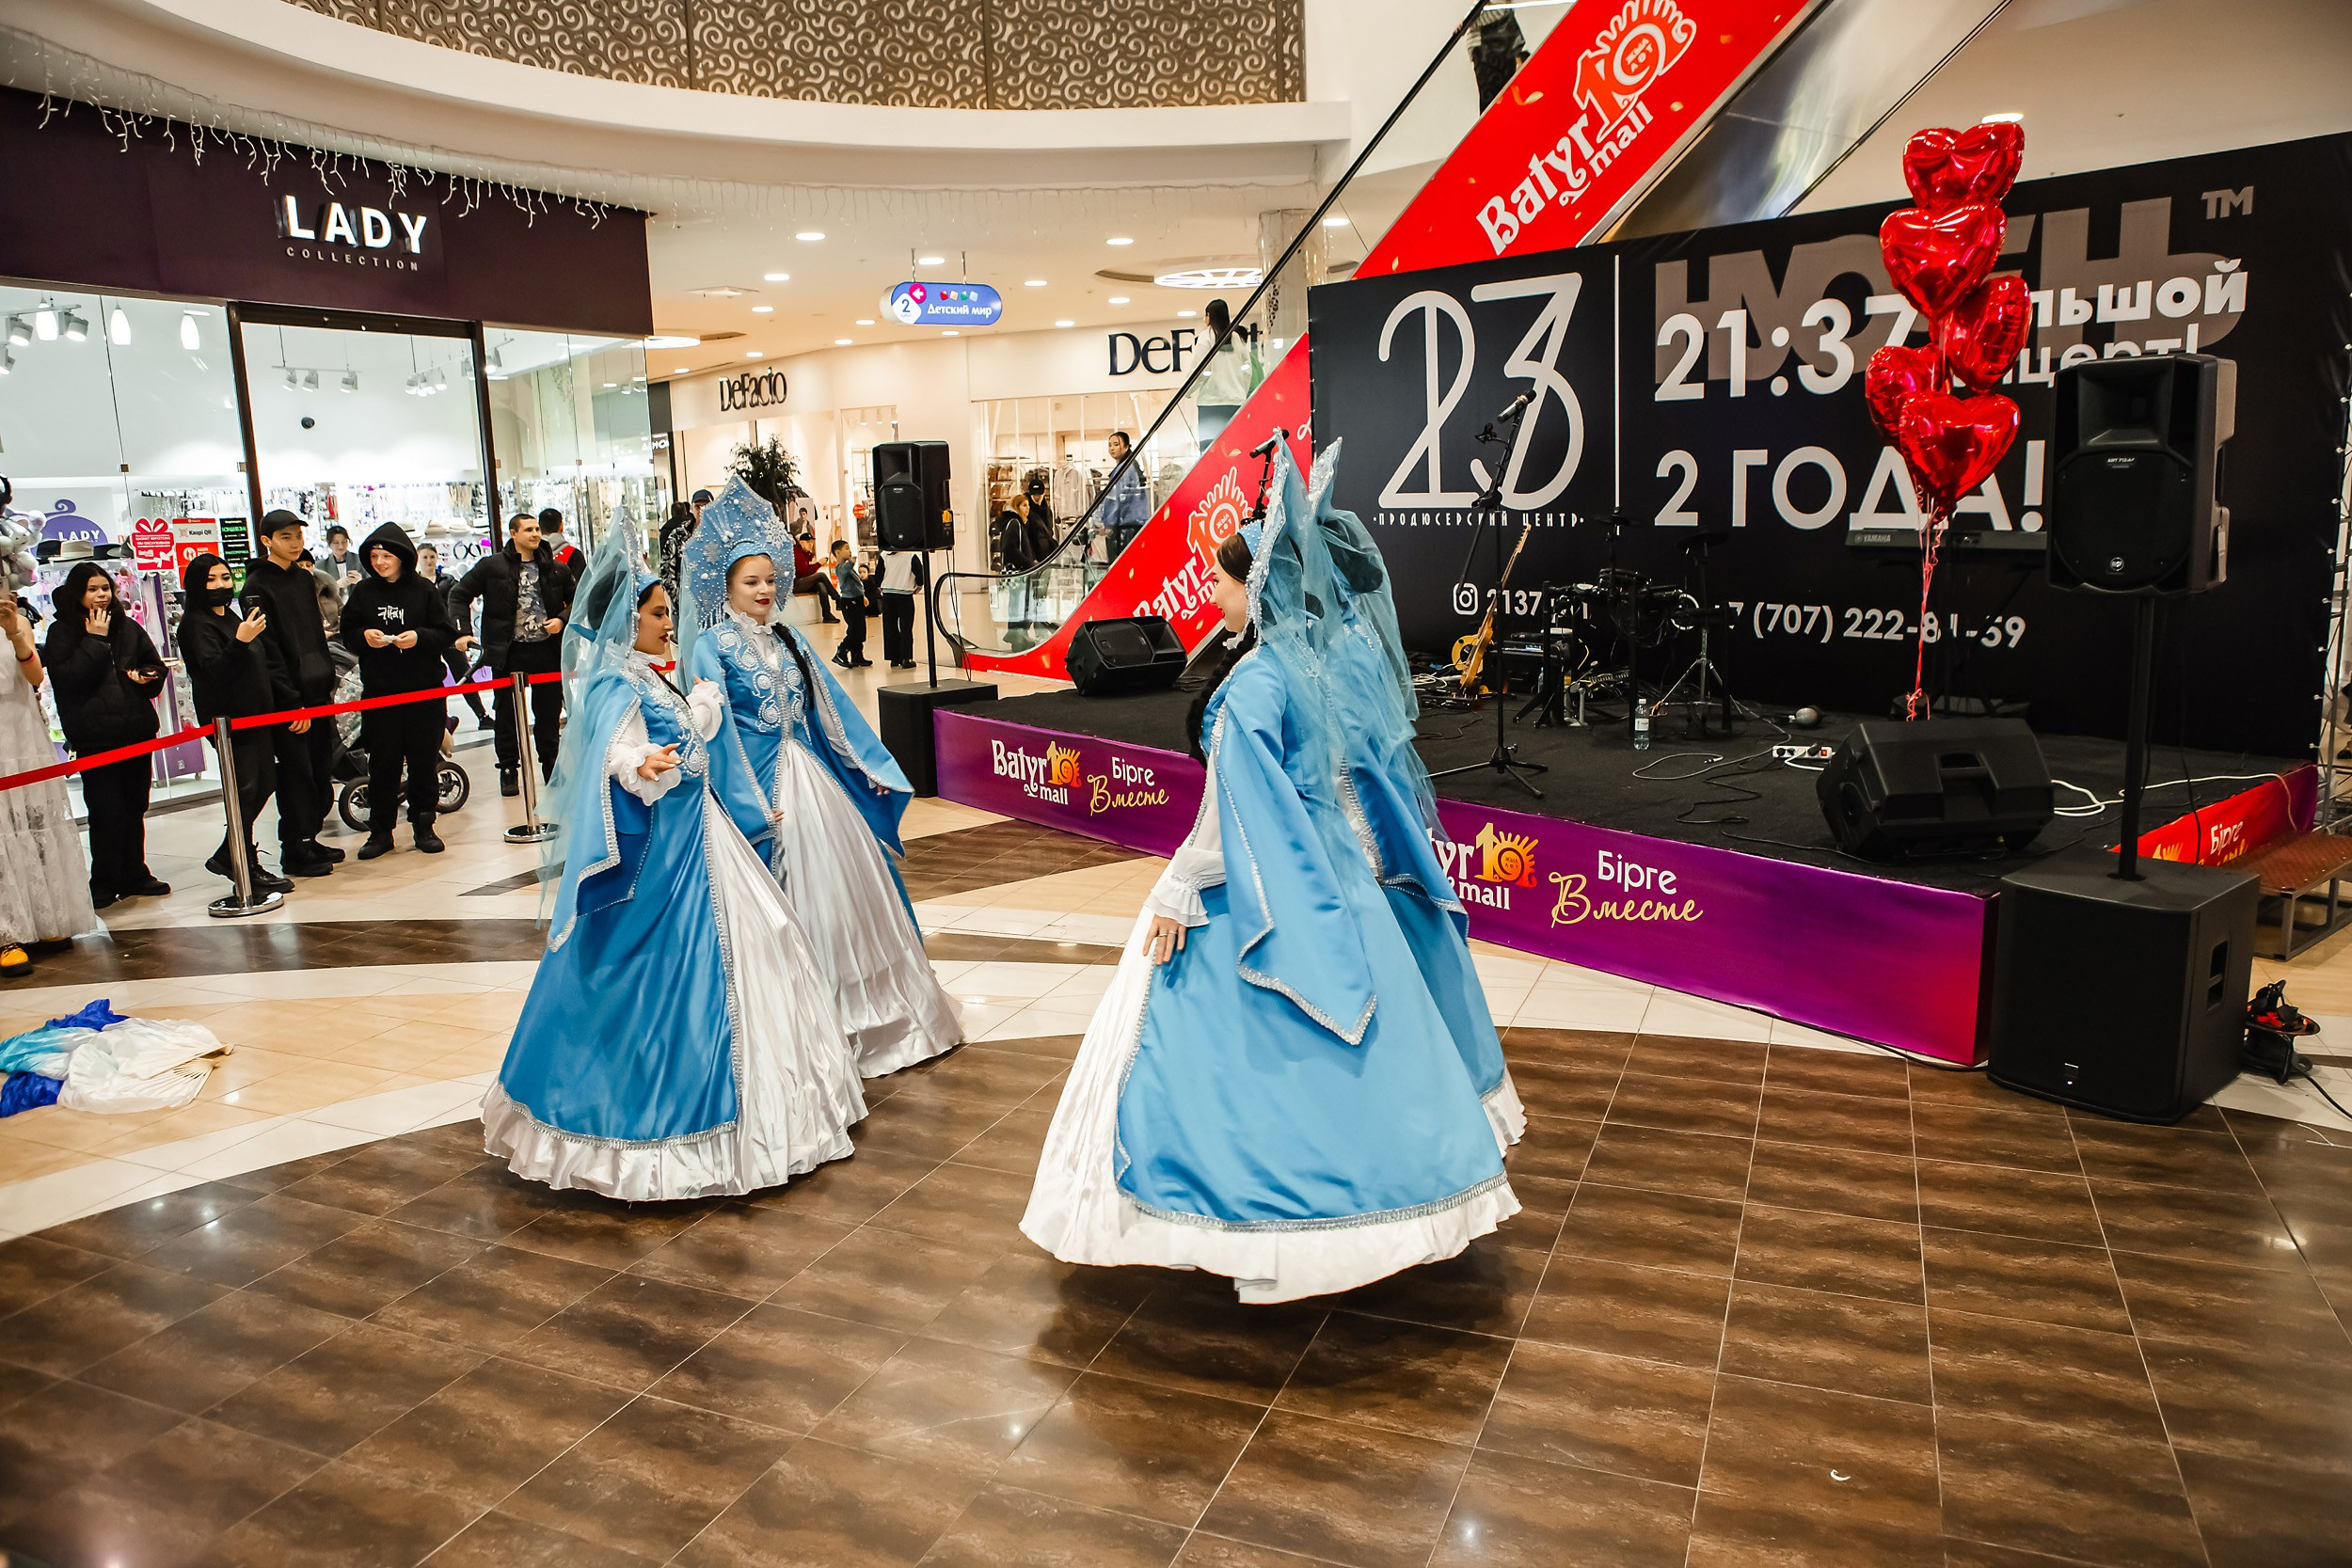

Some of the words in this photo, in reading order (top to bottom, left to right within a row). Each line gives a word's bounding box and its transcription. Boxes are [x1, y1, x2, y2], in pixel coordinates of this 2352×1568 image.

[1588, 101, 1654, 177] mall
[1475, 113, 1595, 256] Batyr
[285, 195, 427, 254] LADY
[286, 246, 419, 271] COLLECTION
[901, 299, 911, 313] 2
[927, 303, 970, 315] Детский
[971, 306, 993, 319] мир
[2029, 259, 2249, 328] льшой
[719, 366, 787, 412] DeFacto
[1378, 272, 1584, 510] 23
[1654, 450, 1699, 526] 2
[1732, 439, 2045, 532] ГОДА!
[58, 530, 100, 542] LADY
[1522, 512, 1578, 528] ЦЕНТР
[1864, 534, 1891, 543] YAMAHA
[1753, 602, 1834, 643] (707)
[991, 739, 1047, 798] Batyr
[1112, 756, 1155, 787] Бірге
[1040, 786, 1069, 806] mall
[1087, 774, 1169, 816] Вместе
[2211, 820, 2244, 855] Бірге
[1597, 850, 1677, 895] Бірге
[1458, 881, 1510, 910] mall
[1548, 871, 1704, 928] Вместе
